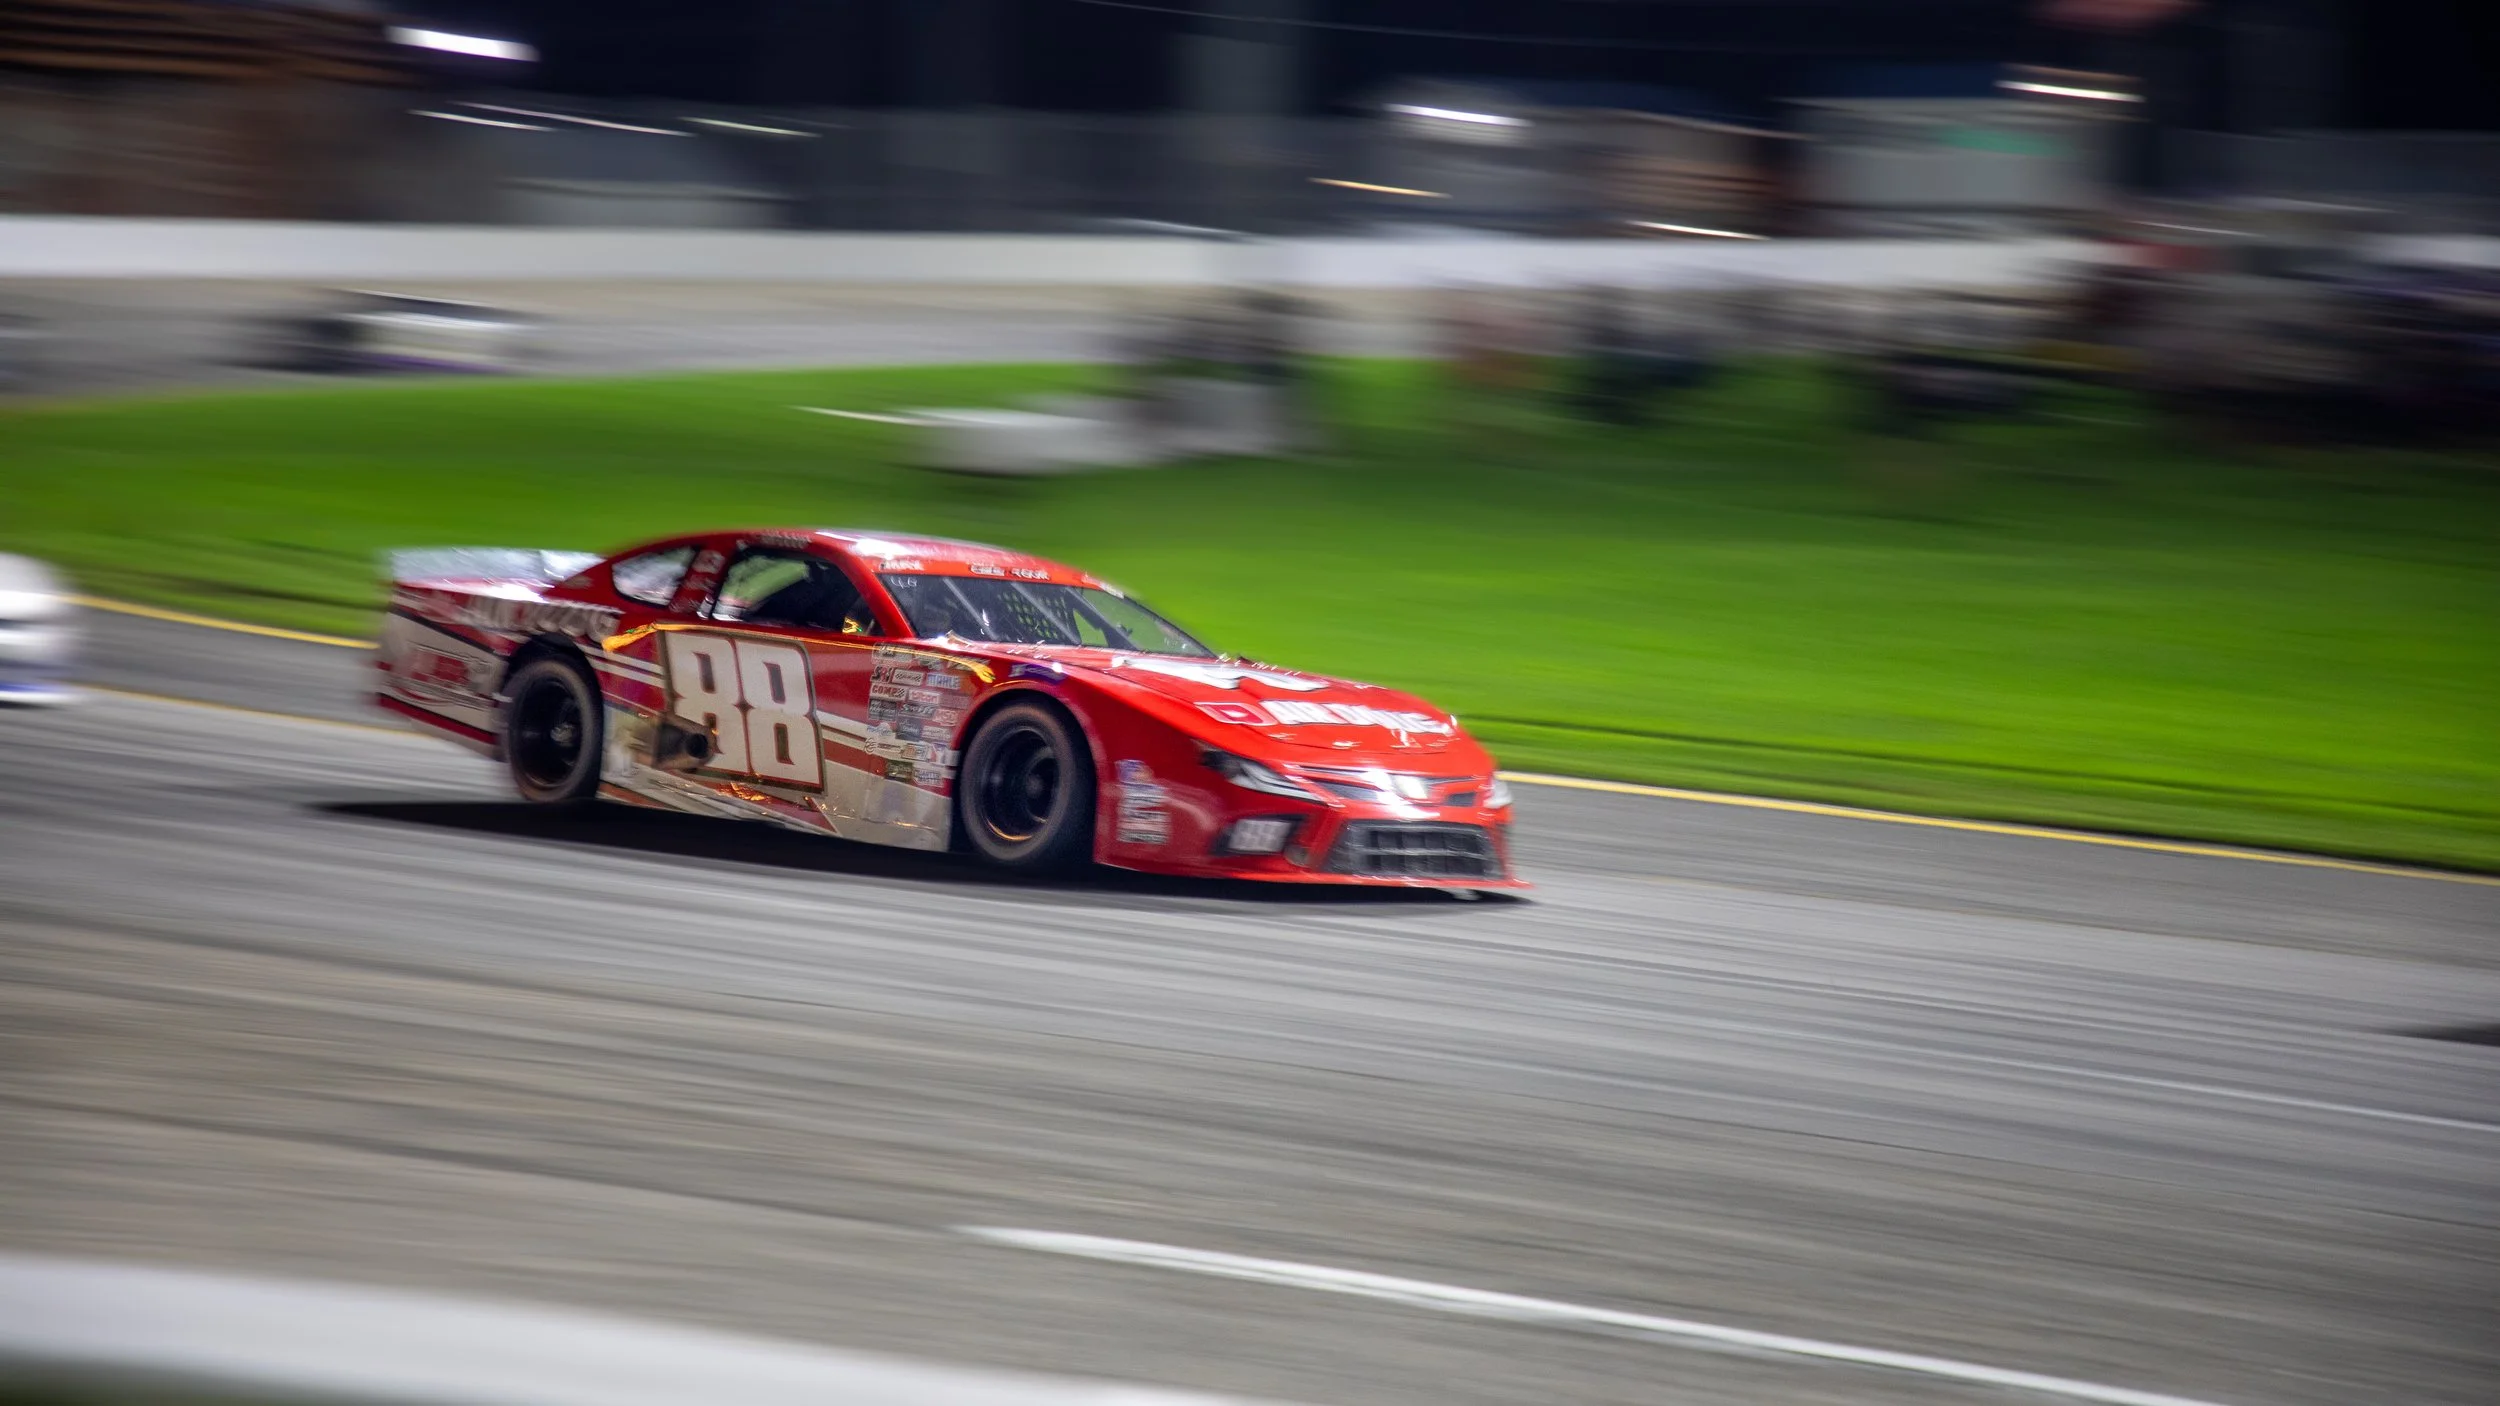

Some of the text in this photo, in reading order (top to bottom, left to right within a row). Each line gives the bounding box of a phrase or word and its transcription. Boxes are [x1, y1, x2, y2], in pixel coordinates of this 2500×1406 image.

[872, 685, 897, 697] COMP
[662, 629, 822, 787] 88
[1229, 819, 1291, 851] 88
